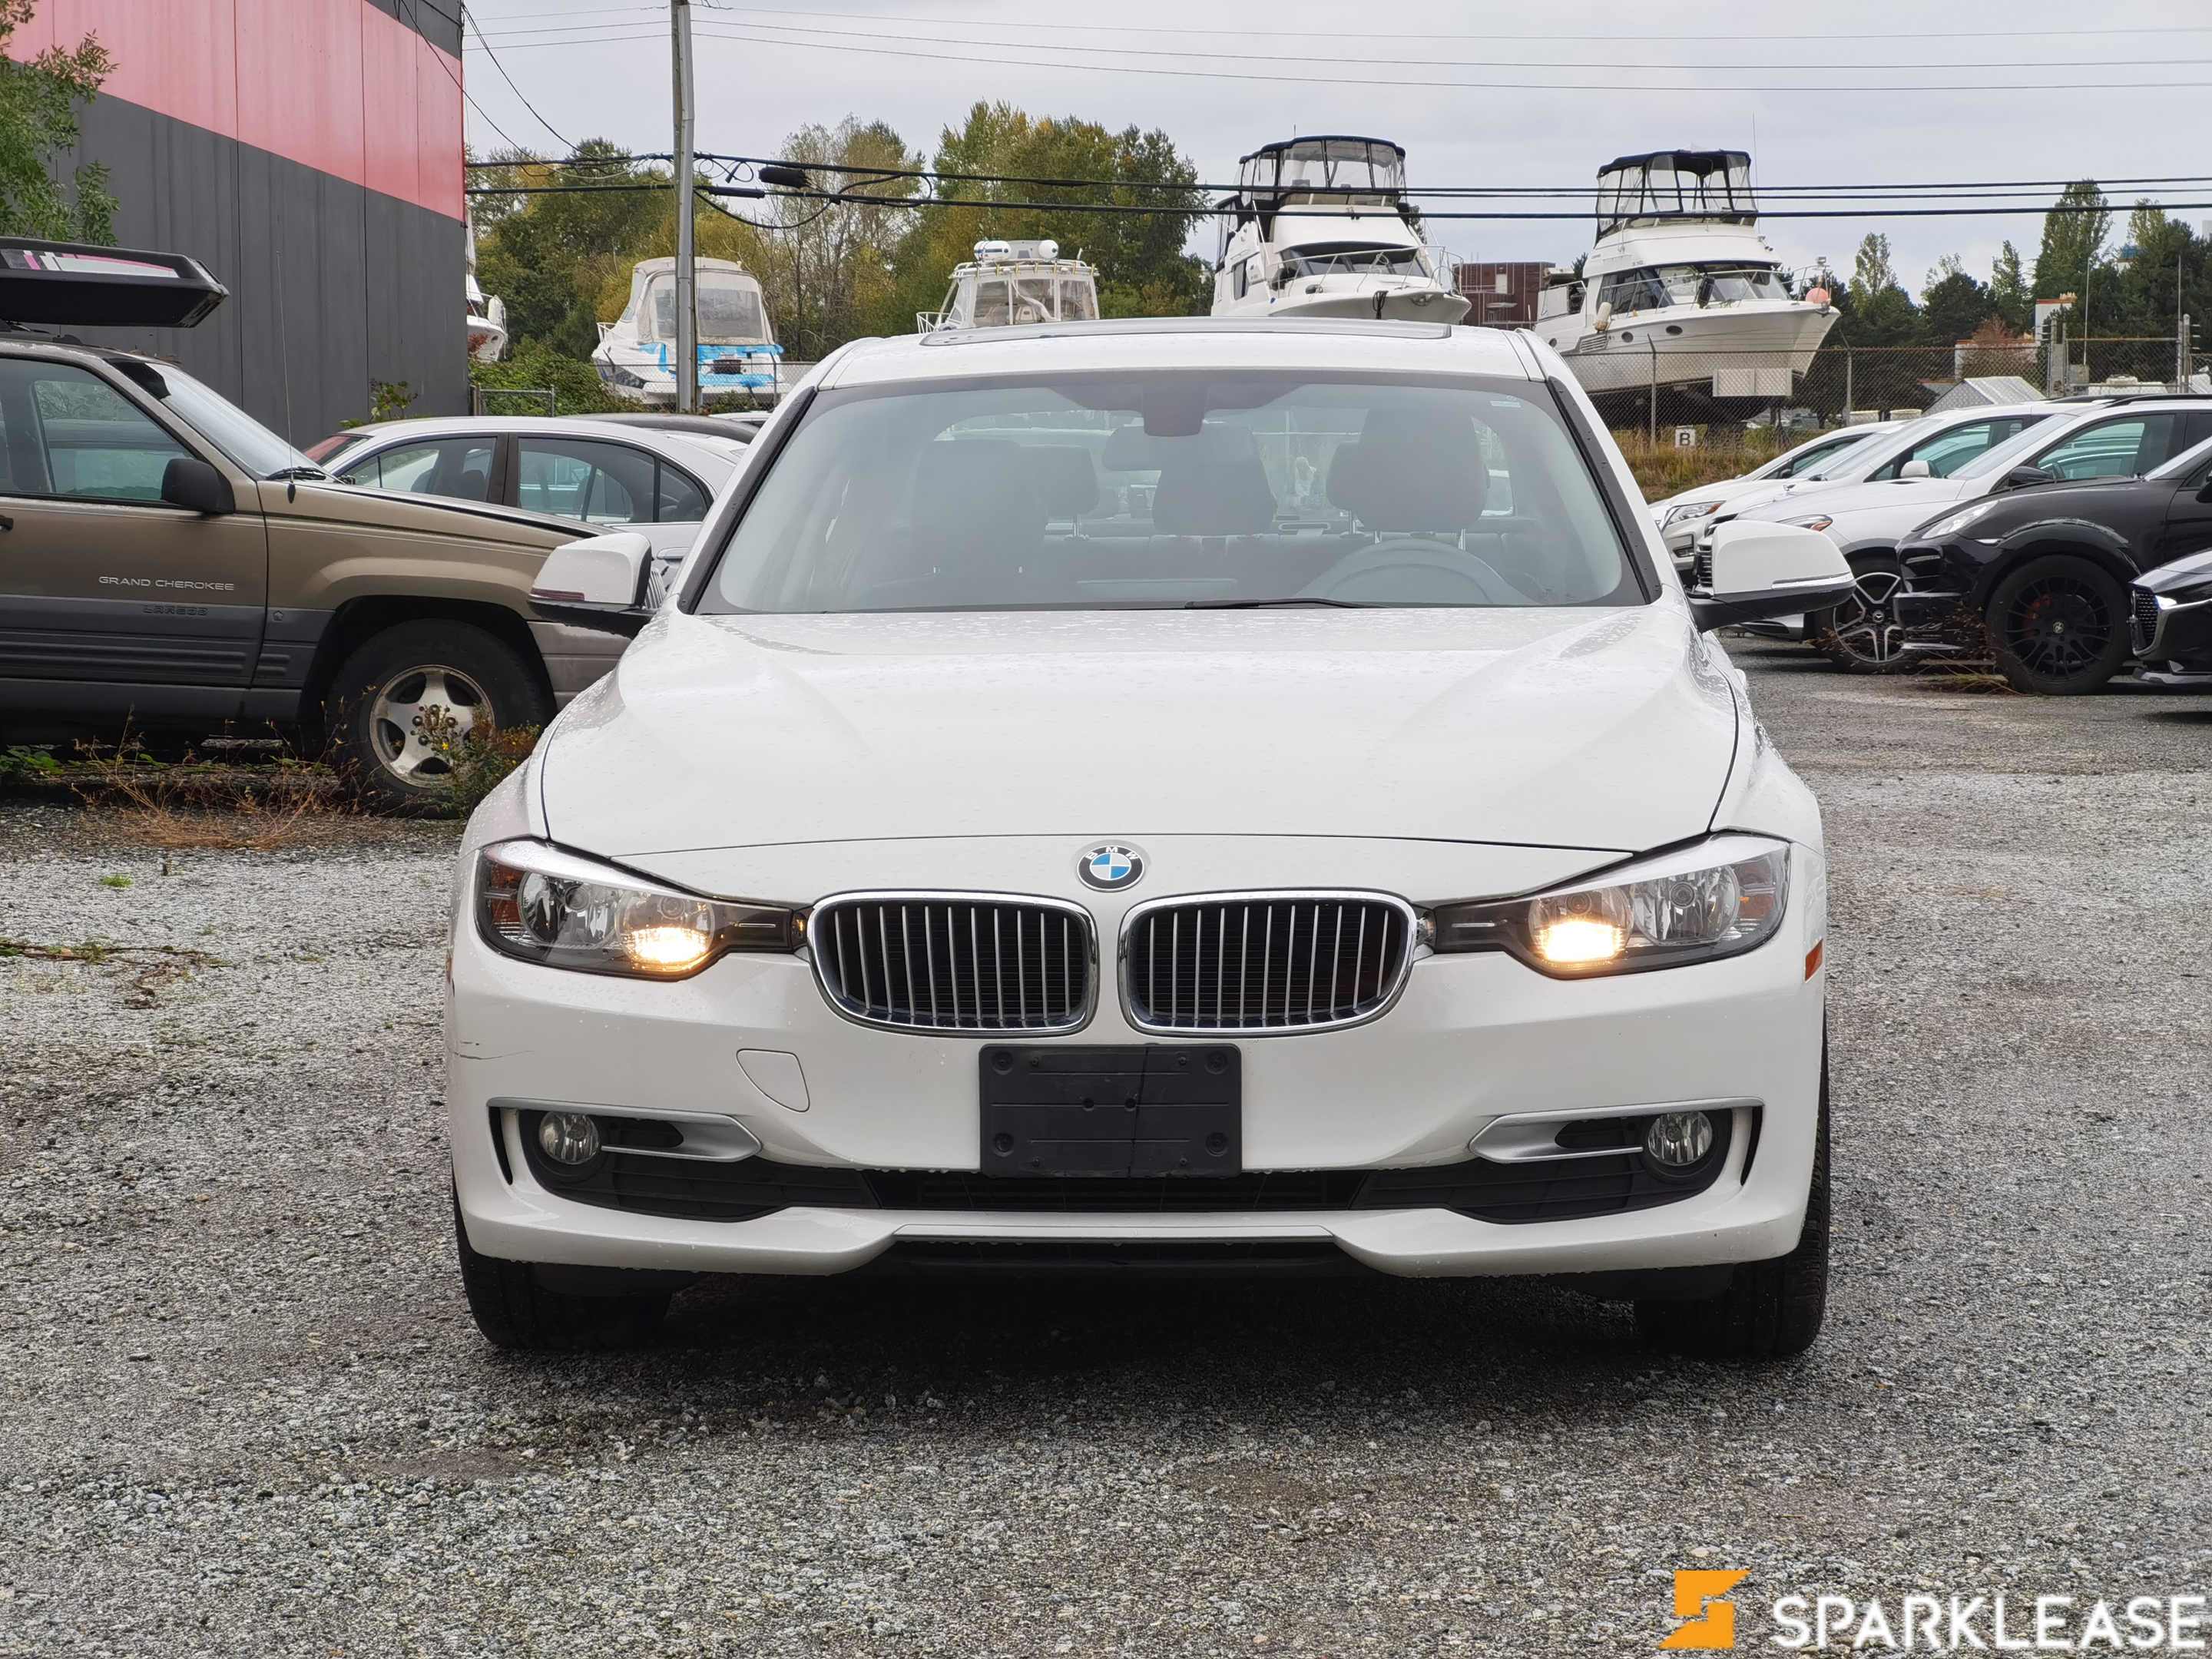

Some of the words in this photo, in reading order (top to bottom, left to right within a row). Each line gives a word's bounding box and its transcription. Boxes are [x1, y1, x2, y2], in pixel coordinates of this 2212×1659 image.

[1680, 432, 1690, 445] B
[98, 576, 151, 587] GRAND
[155, 580, 234, 591] CHEROKEE
[1085, 846, 1140, 860] BMW
